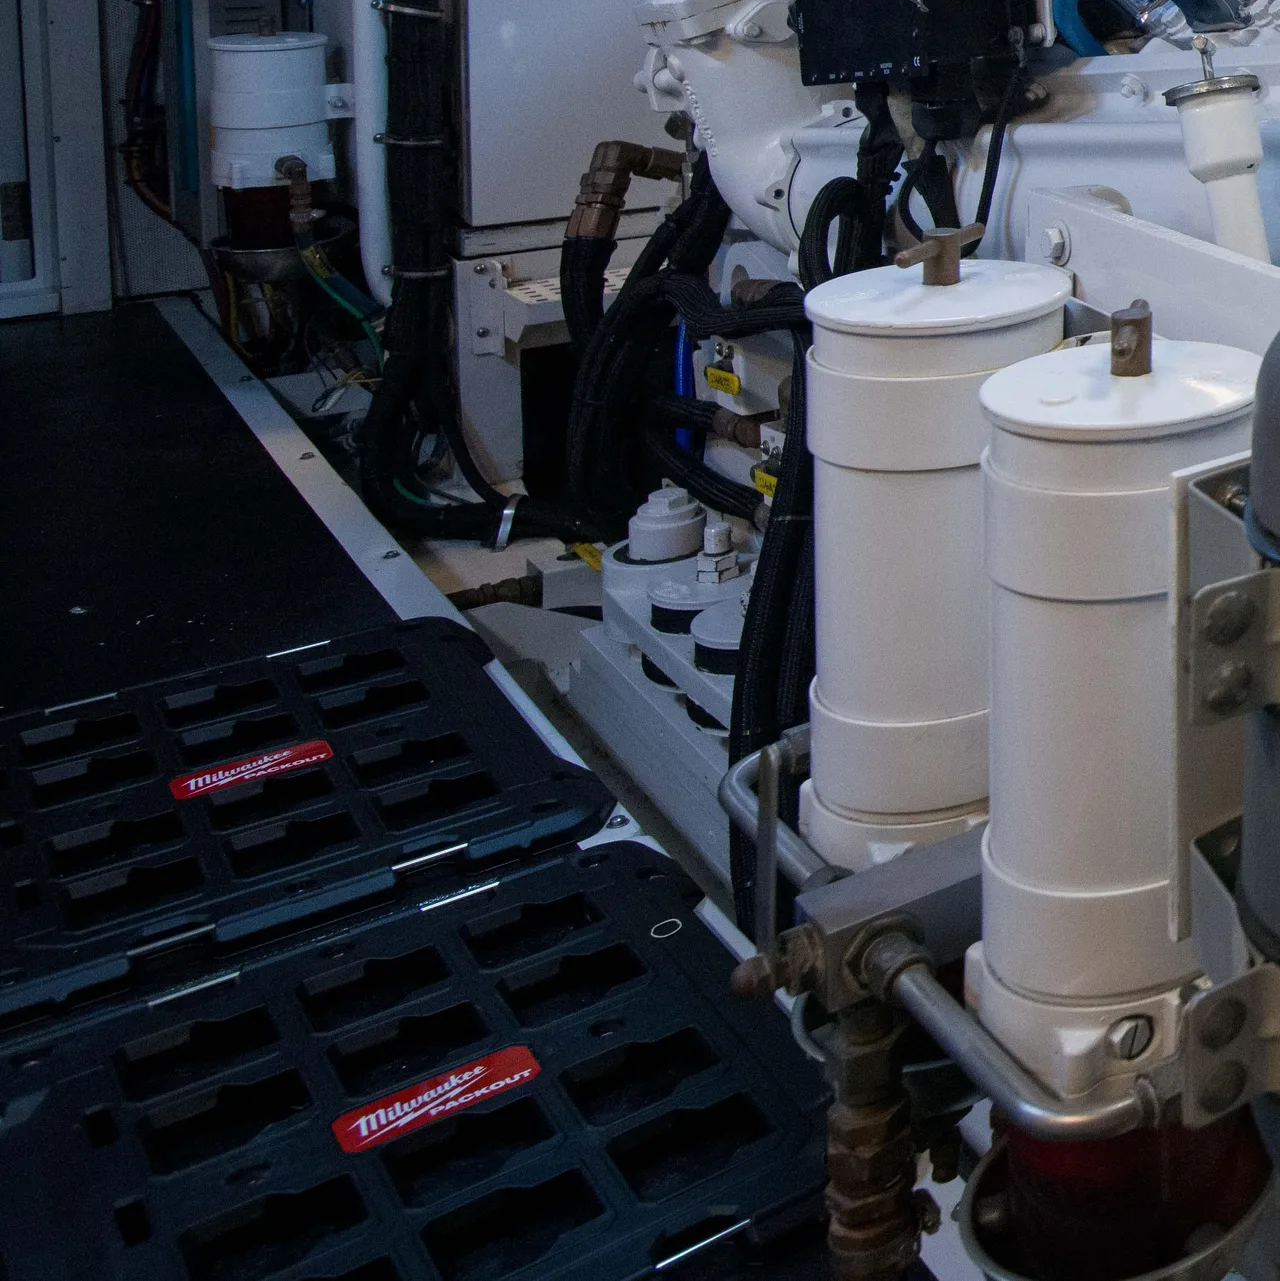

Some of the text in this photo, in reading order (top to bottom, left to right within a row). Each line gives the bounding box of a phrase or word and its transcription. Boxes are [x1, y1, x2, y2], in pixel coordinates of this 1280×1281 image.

[181, 749, 295, 791] Milwaukee
[244, 753, 328, 780] PACKOUT
[348, 1065, 488, 1137] Milwaukee
[428, 1068, 533, 1116] PACKOUT
